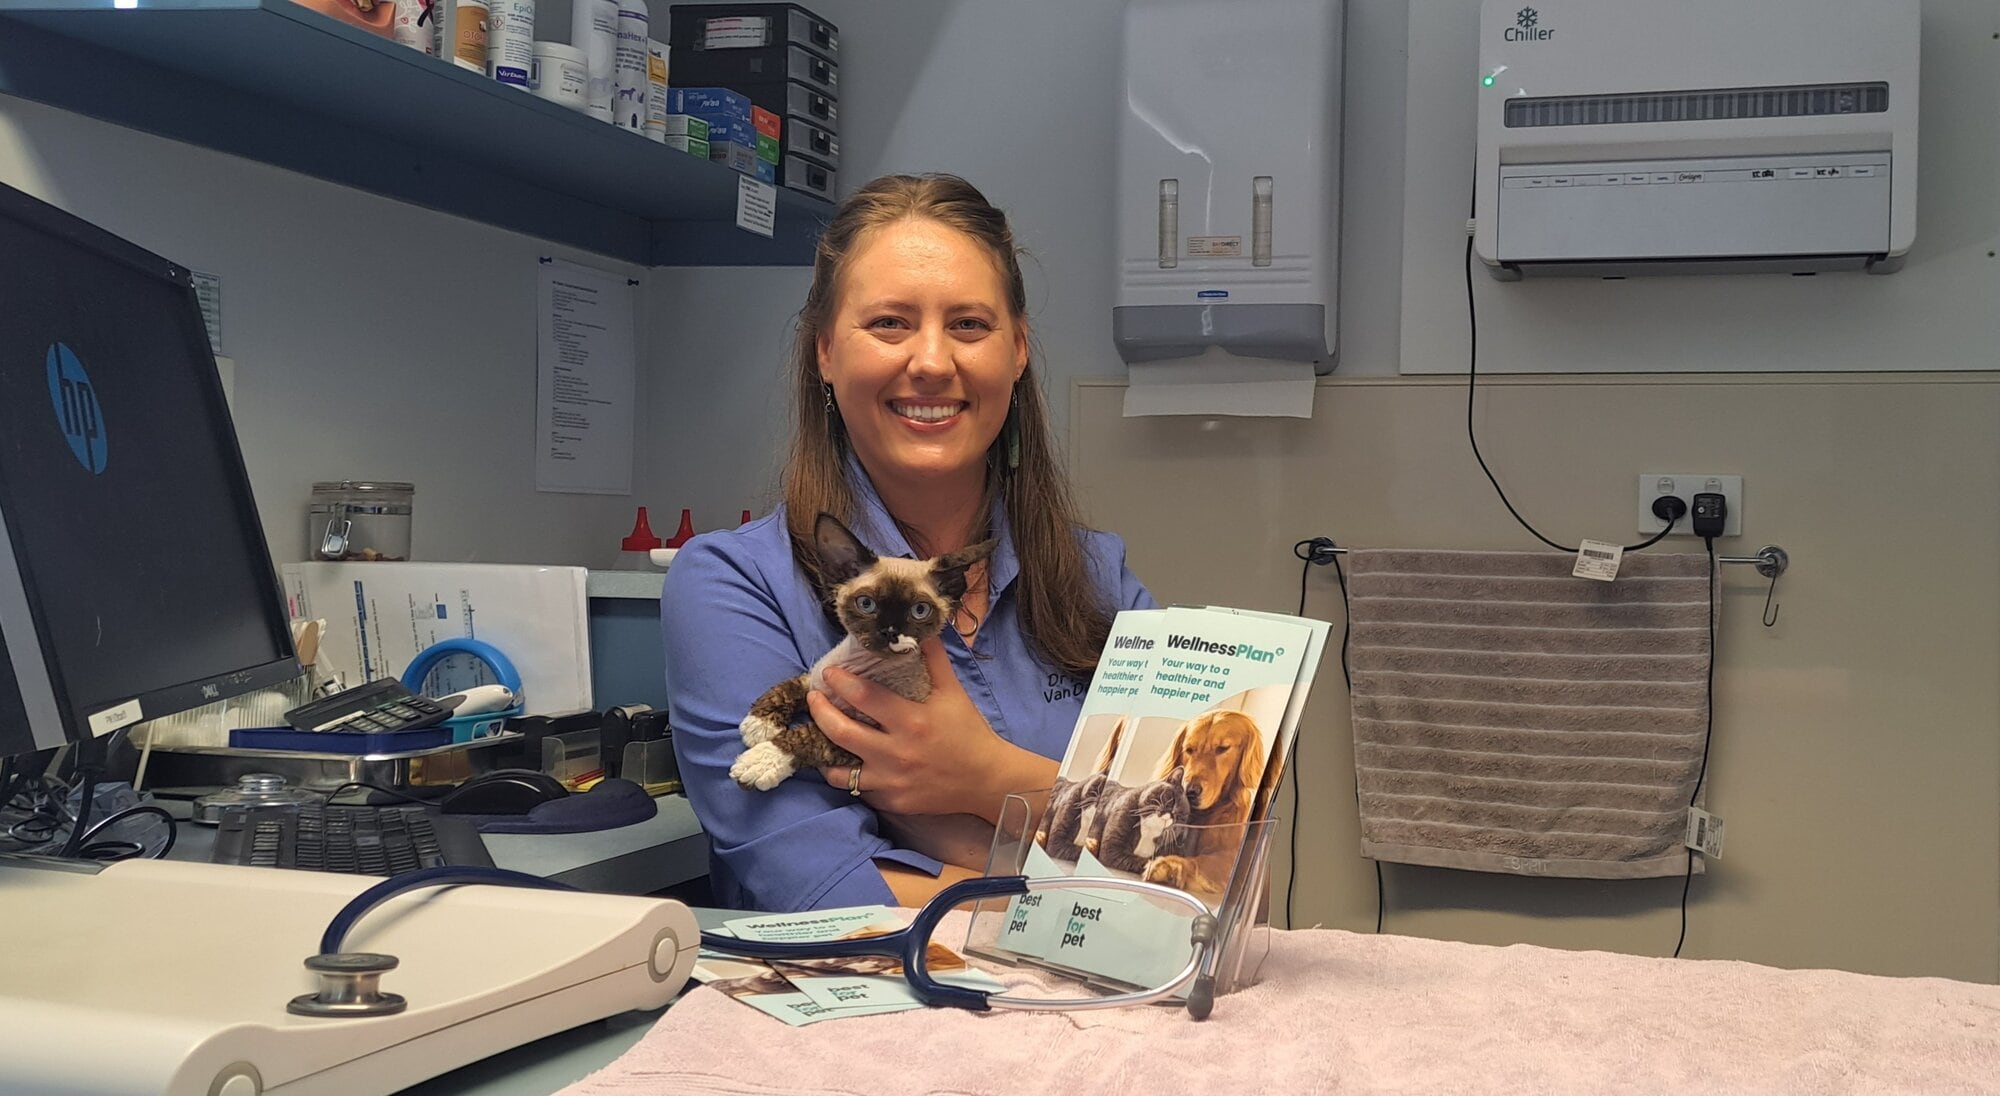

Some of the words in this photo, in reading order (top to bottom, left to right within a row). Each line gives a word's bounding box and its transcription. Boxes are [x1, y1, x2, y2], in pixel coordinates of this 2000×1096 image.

[1504, 27, 1555, 41] Chiller
[55, 341, 98, 473] hp
[1167, 634, 1275, 663] WellnessPlan
[1109, 658, 1126, 667] Your
[1126, 659, 1143, 670] way
[1162, 657, 1184, 668] Your
[1185, 661, 1208, 674] way
[1209, 664, 1220, 673] to
[1222, 667, 1230, 675] a
[1048, 673, 1066, 687] Dr
[1102, 671, 1138, 681] healthier
[1155, 671, 1202, 685] healthier
[1203, 679, 1226, 689] and
[1098, 684, 1128, 696] happier
[1150, 685, 1190, 698] happier
[1191, 692, 1210, 703] pet
[1503, 857, 1551, 873] ESPRIT
[1020, 893, 1042, 907] best
[1014, 905, 1029, 920] for
[1072, 902, 1102, 921] best
[746, 916, 868, 928] WellnessPlan
[1008, 920, 1027, 935] pet
[1066, 917, 1085, 933] for
[1060, 932, 1085, 949] pet
[827, 984, 870, 992] best
[837, 994, 869, 1002] pet
